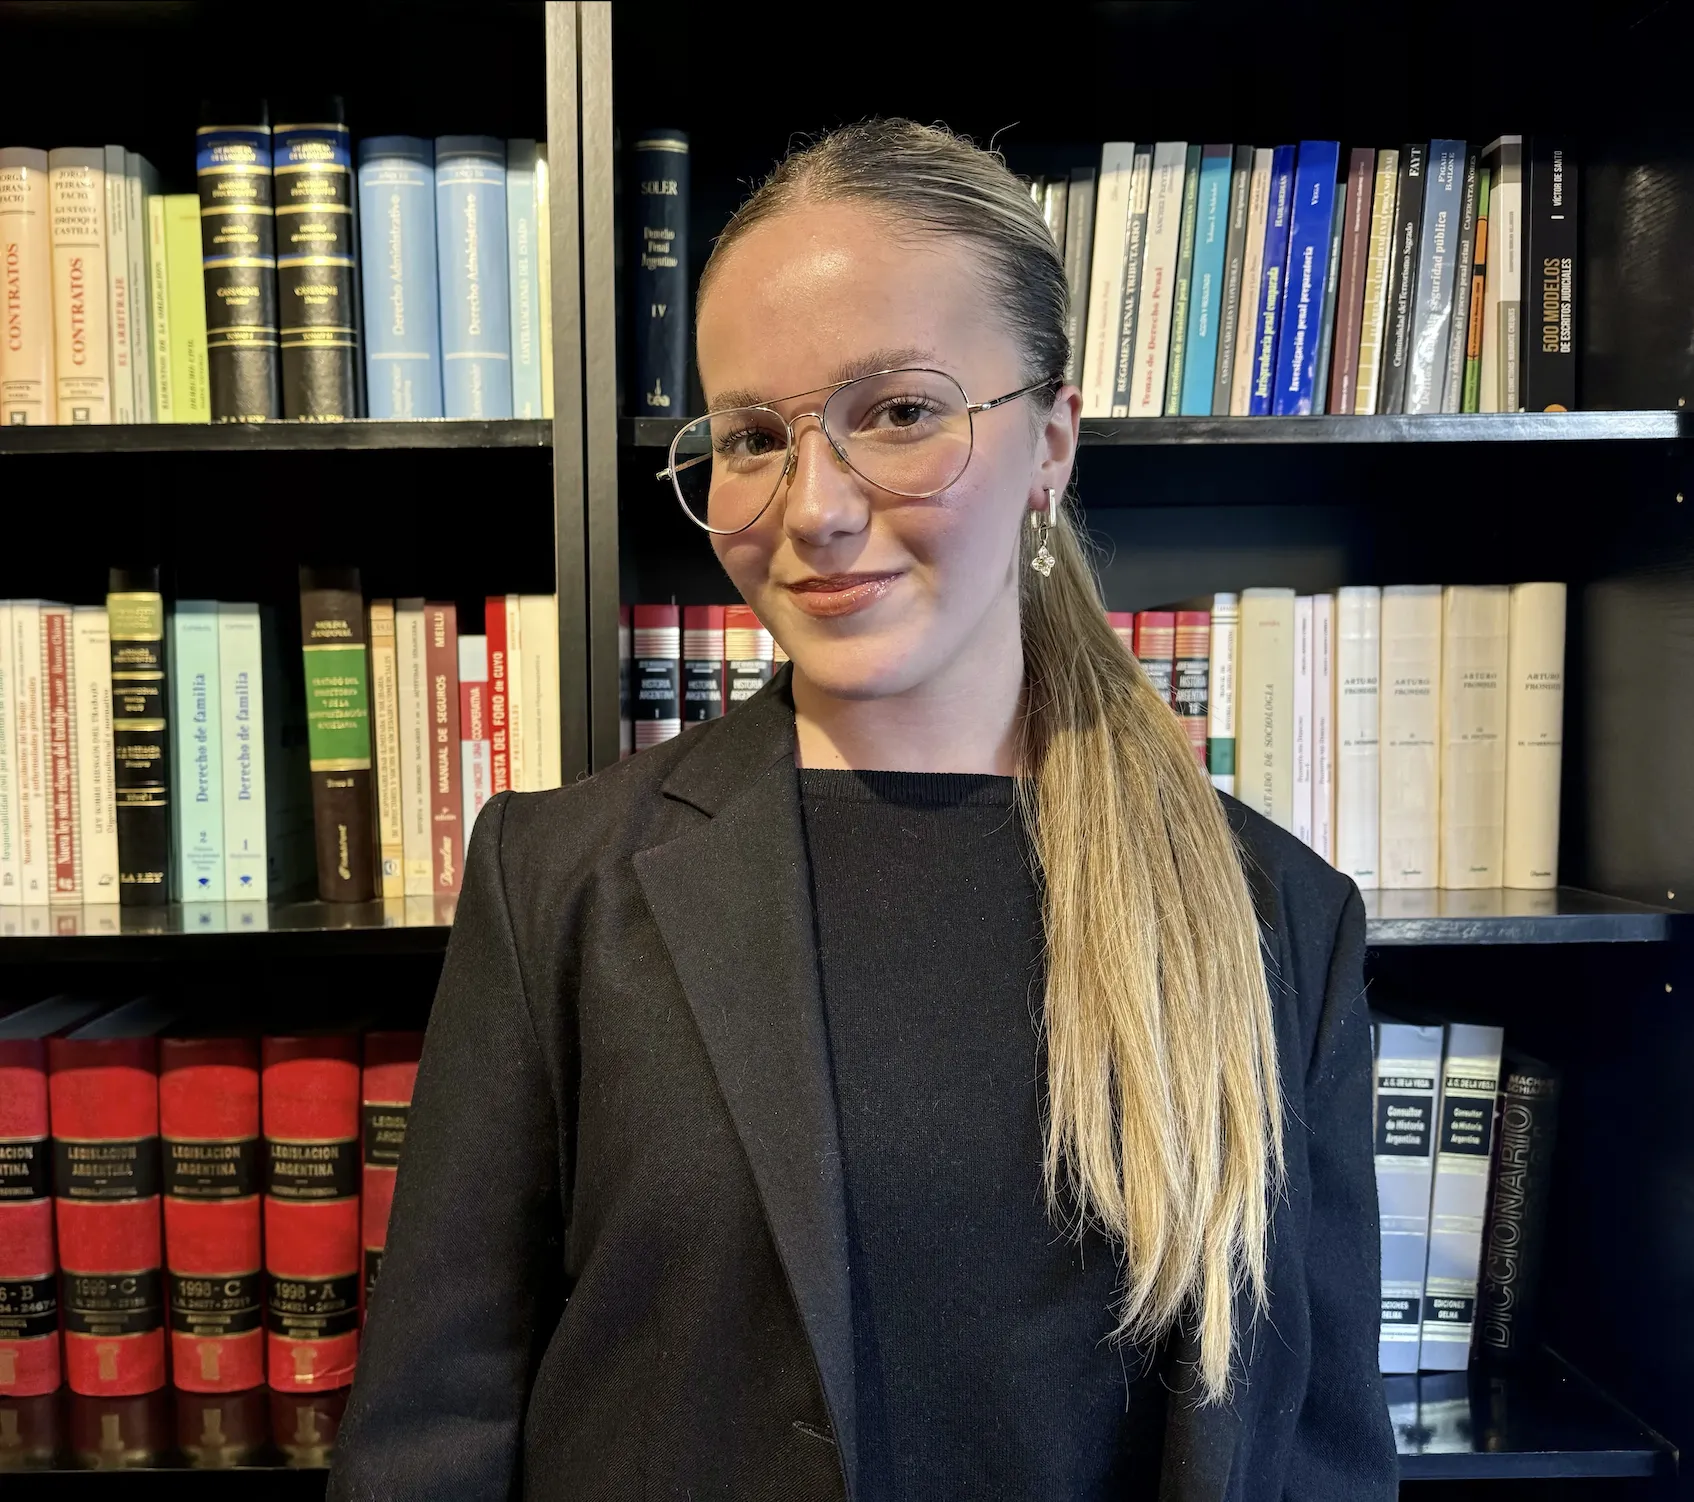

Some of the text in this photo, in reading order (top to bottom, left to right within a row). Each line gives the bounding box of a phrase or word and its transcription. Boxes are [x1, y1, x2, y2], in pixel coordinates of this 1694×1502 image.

[1408, 147, 1422, 177] FAYT
[1437, 151, 1448, 183] FIGARI
[1445, 151, 1456, 191] BAILONE
[641, 181, 678, 195] SOLER
[1551, 150, 1563, 206] VÍCTOR DE SANTO
[644, 226, 676, 240] Derecho
[1432, 210, 1447, 254] pública
[648, 240, 670, 253] Penal
[1460, 239, 1470, 264] actual
[388, 194, 405, 336] Derecho Administrativo
[463, 193, 481, 336] Derecho Administrativo
[641, 253, 679, 270] Argentino
[1428, 254, 1445, 312] seguridad
[1458, 265, 1470, 287] penal
[9, 243, 22, 352] CONTRATOS
[1116, 220, 1141, 392] RÉGIMEN PENAL TRIBUTARIO
[1392, 222, 1415, 368] Criminalidad del Terrorismo Sagrado
[1456, 286, 1467, 316] proceso
[1543, 258, 1561, 353] 500 MODELOS
[1560, 258, 1572, 353] DE ESCRITOS JUDICIALES
[69, 257, 85, 367] CONTRATOS
[115, 277, 126, 347] ARBITRAJE
[651, 303, 667, 318] IV
[1288, 246, 1315, 392] Investigación penal preparatoria
[1507, 307, 1516, 333] CHEQUES
[1141, 267, 1163, 407] Temas de Derecho Penal
[1254, 266, 1280, 398] Jurisprudencia penal comparada
[1449, 329, 1462, 374] debilidades
[1507, 393, 1516, 412] ELITOS
[641, 679, 671, 689] HISTORIA
[688, 679, 718, 690] HISTORIA
[733, 678, 763, 689] HISTORIA
[1344, 677, 1378, 686] ARTURO
[1394, 678, 1431, 686] ARTURO
[1527, 672, 1561, 681] ARTURO
[639, 690, 675, 700] ARGENTINA
[685, 690, 722, 701] ARGENTINA
[51, 706, 70, 741] trabajo
[470, 686, 481, 740] COOPERATIVA
[491, 651, 507, 792] EVISTA DEL FORO de CUYO
[654, 708, 660, 719] 1
[1263, 683, 1274, 749] SOCIOLOGIA
[192, 673, 208, 803] Derecho de familia
[236, 672, 252, 801] Derecho de familia
[435, 674, 449, 793] MANUAL DE SEGUROS
[52, 742, 68, 758] del
[1264, 751, 1273, 767] DE
[53, 757, 71, 792] riesgos
[54, 792, 70, 819] sobre
[57, 834, 71, 865] Nueva
[439, 836, 453, 887] Depalma
[1413, 1079, 1431, 1089] VEGA
[1477, 1081, 1495, 1090] VEGA
[1387, 1105, 1423, 1119] Consultor
[1453, 1107, 1484, 1119] Consultor
[1385, 1119, 1425, 1132] de Historia
[1451, 1121, 1483, 1132] de Historia
[1385, 1133, 1422, 1146] Argentina
[1450, 1133, 1481, 1145] Argentina
[68, 1146, 137, 1160] LEGISLACION
[172, 1145, 241, 1159] LEGISLACION
[271, 1145, 340, 1159] LEGISLACION
[71, 1162, 133, 1177] ARGENTINA
[176, 1162, 236, 1176] ARGENTINA
[274, 1162, 334, 1177] ARGENTINA
[1484, 1103, 1534, 1349] DICCIONARIO
[1433, 1298, 1466, 1309] EDICIONES
